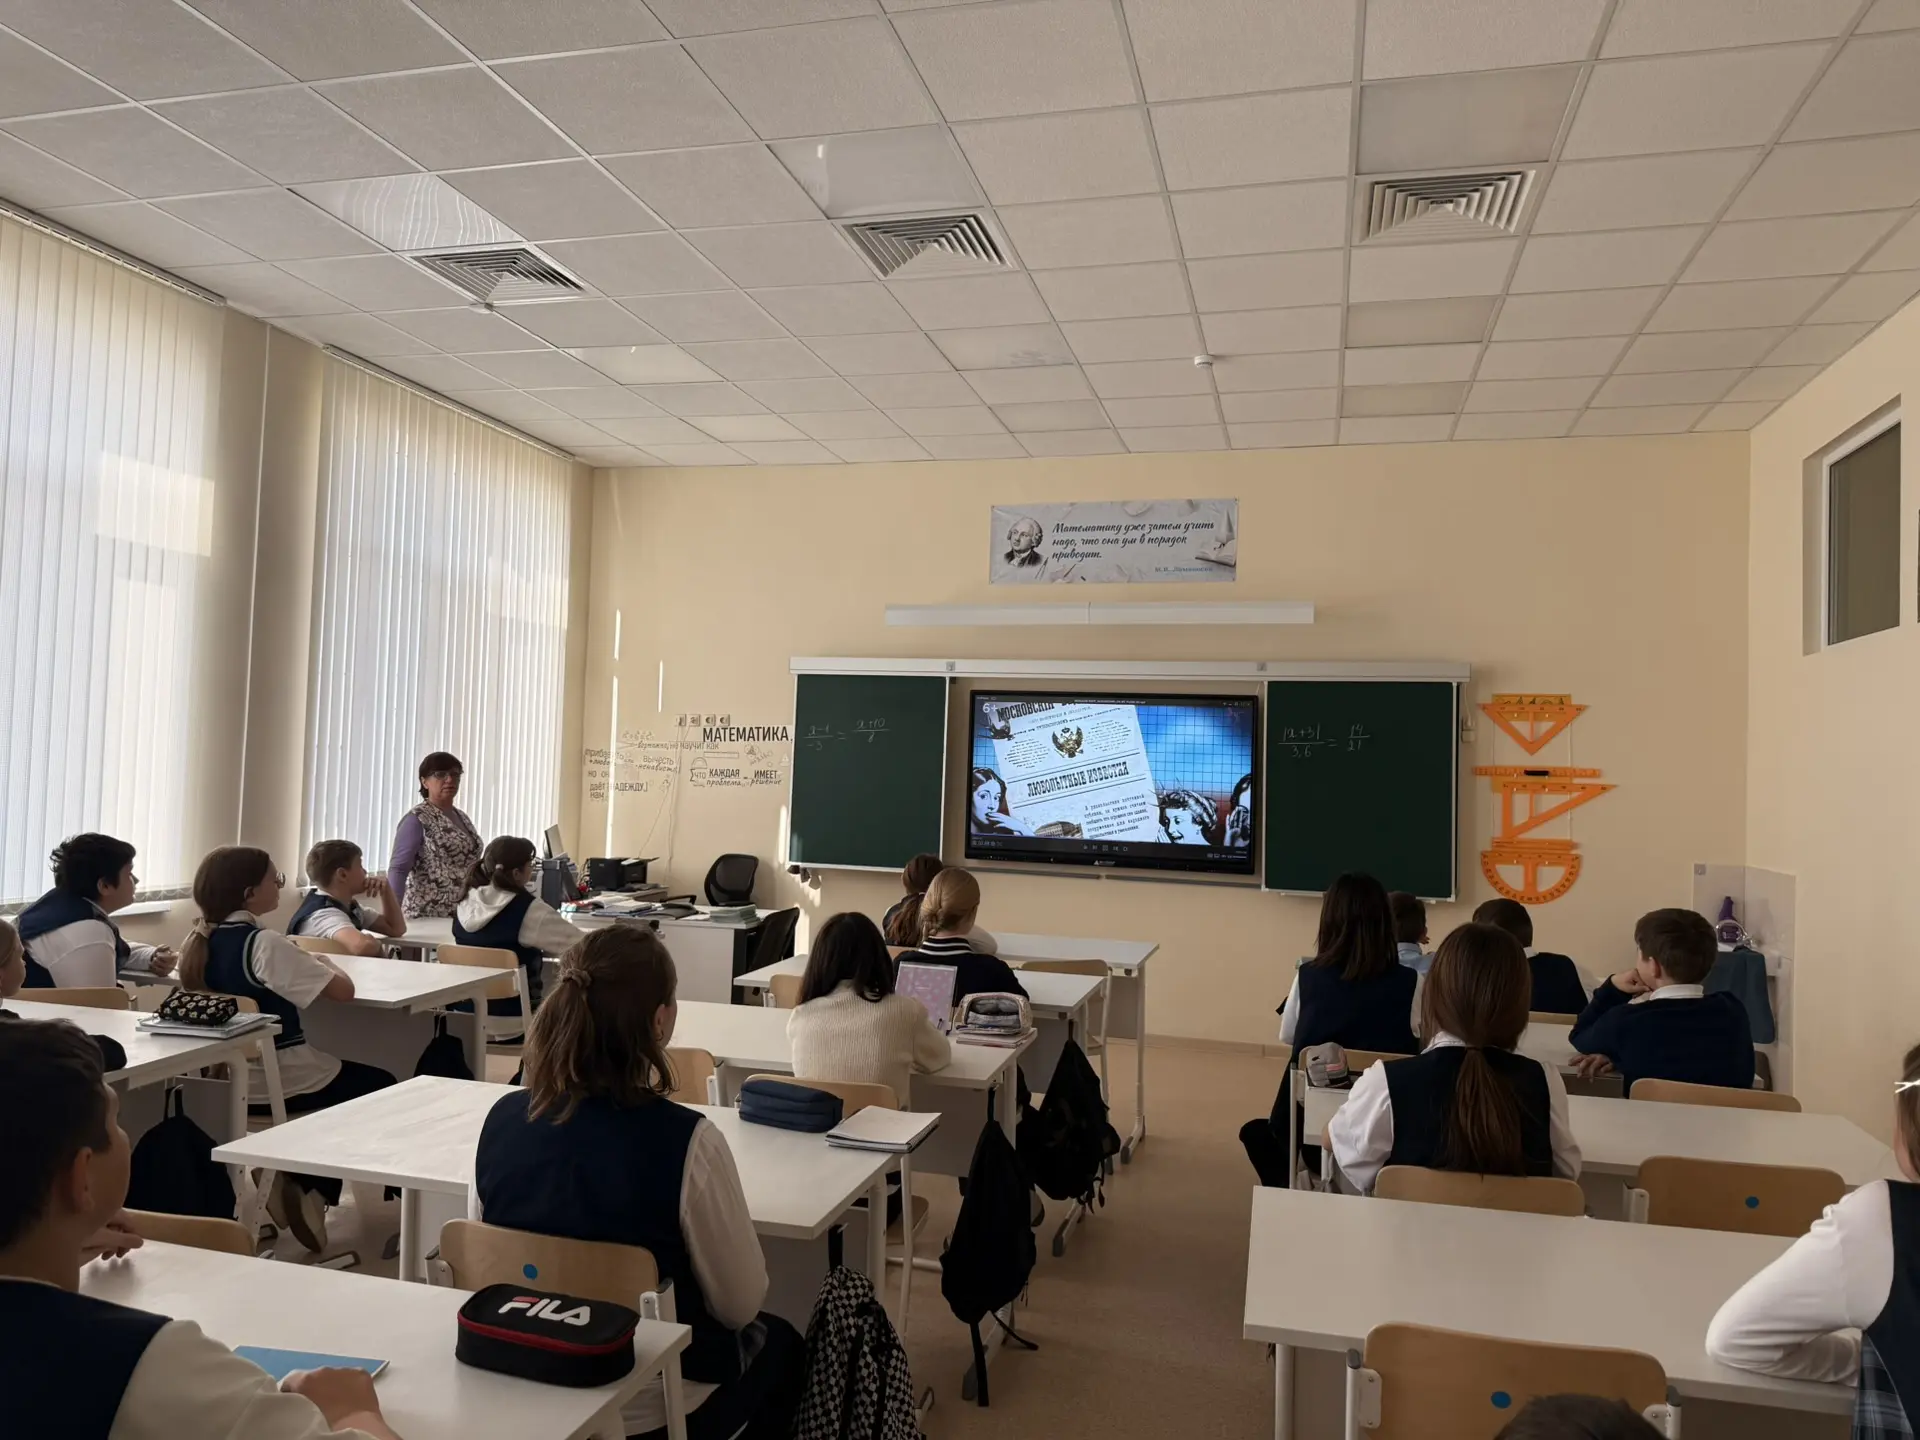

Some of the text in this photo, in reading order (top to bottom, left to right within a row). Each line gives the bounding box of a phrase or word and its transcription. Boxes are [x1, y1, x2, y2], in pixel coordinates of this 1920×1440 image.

[1052, 521, 1215, 535] Математику уже затем учить
[1052, 532, 1188, 549] надо, что она ум в порядок
[1052, 547, 1102, 562] приводит.
[982, 702, 998, 714] 6+
[709, 768, 740, 778] КАЖДАЯ
[754, 770, 778, 779] ИМЕЕТ
[498, 1296, 590, 1326] FILA
